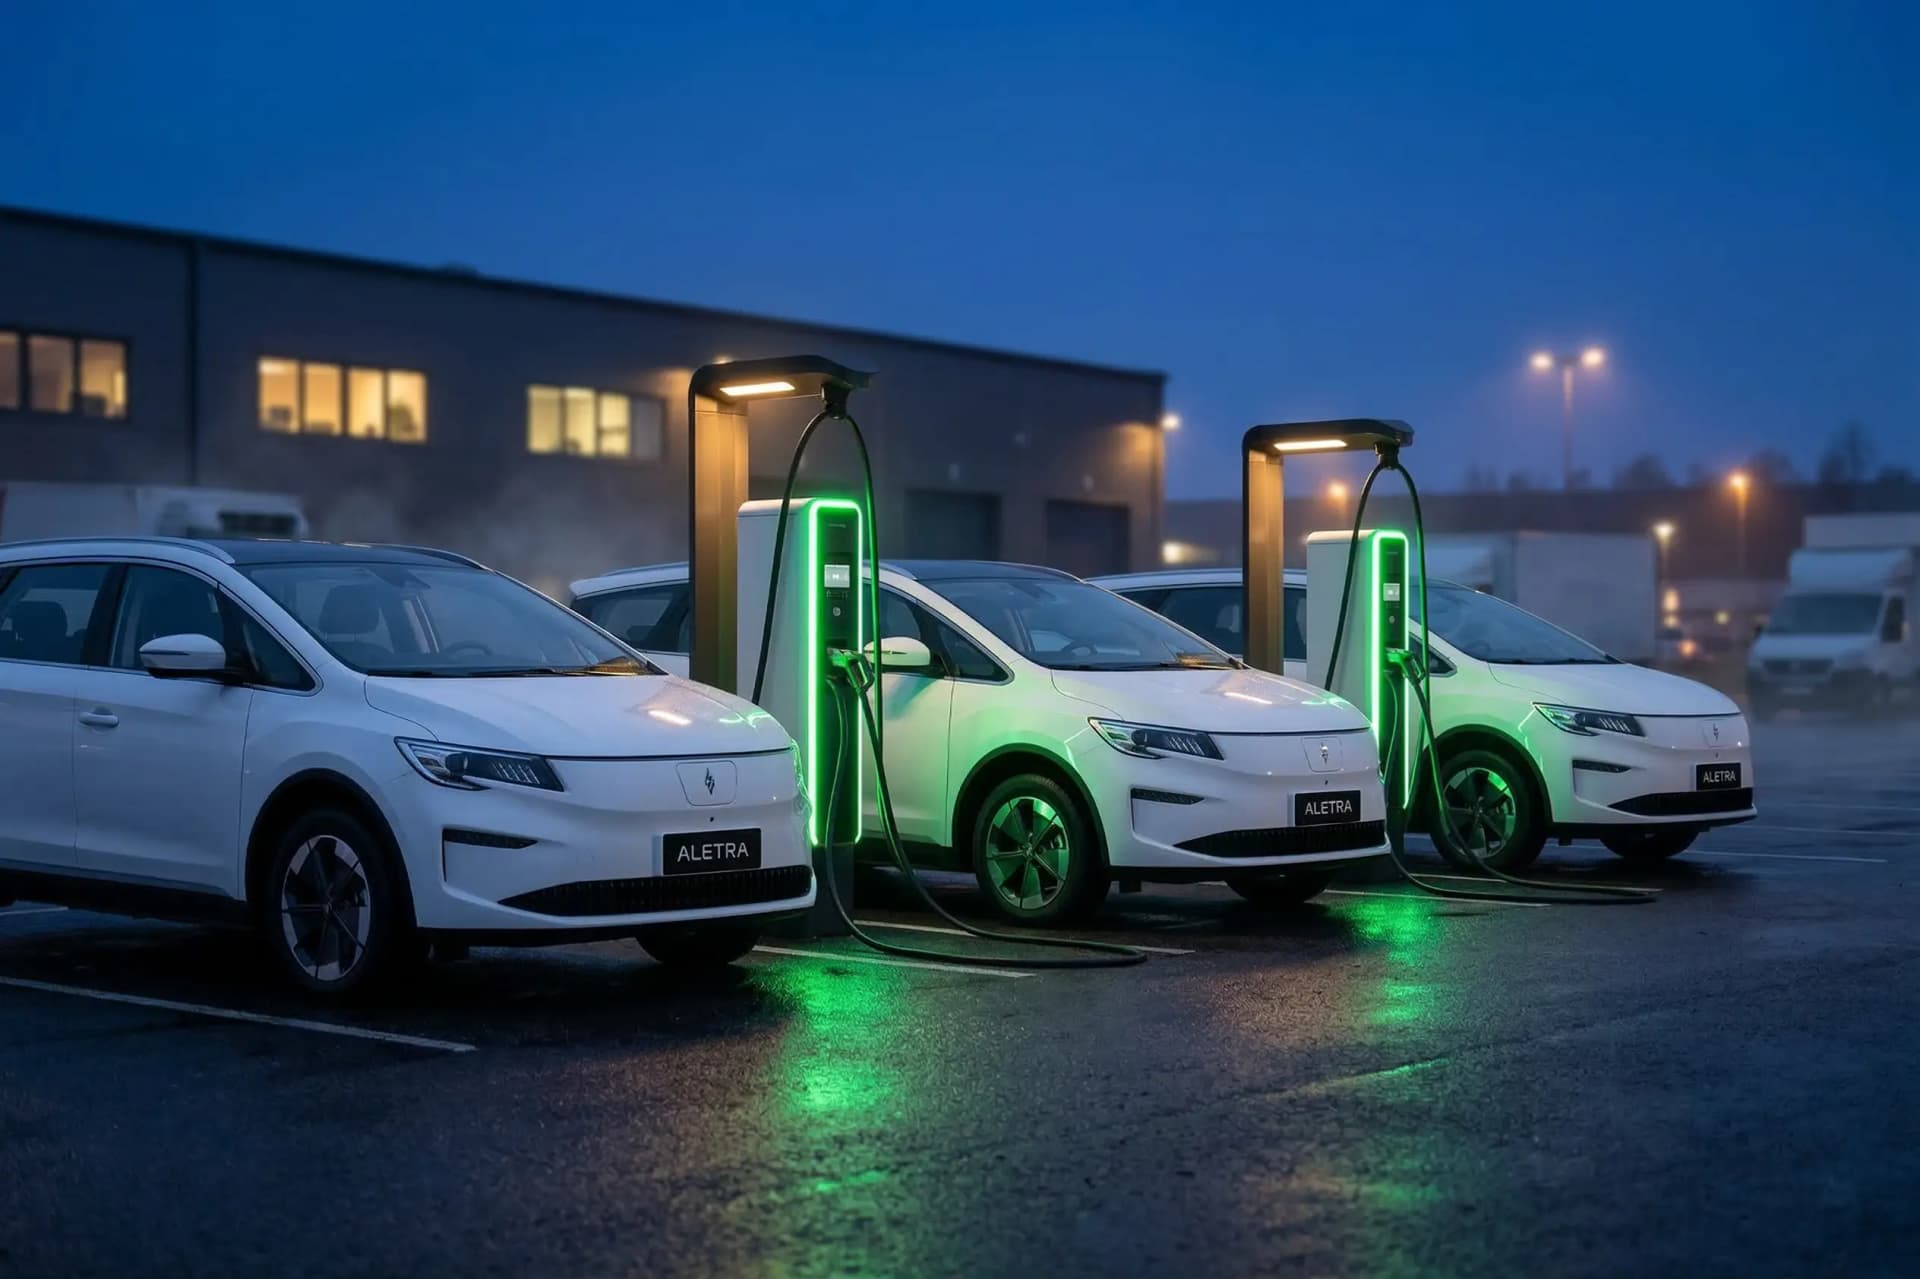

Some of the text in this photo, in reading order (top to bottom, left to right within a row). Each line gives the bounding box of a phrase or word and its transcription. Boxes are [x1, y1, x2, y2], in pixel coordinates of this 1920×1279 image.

[1703, 770, 1736, 783] ALETRA
[1304, 800, 1352, 816] ALETRA
[676, 842, 749, 862] ALETRA
